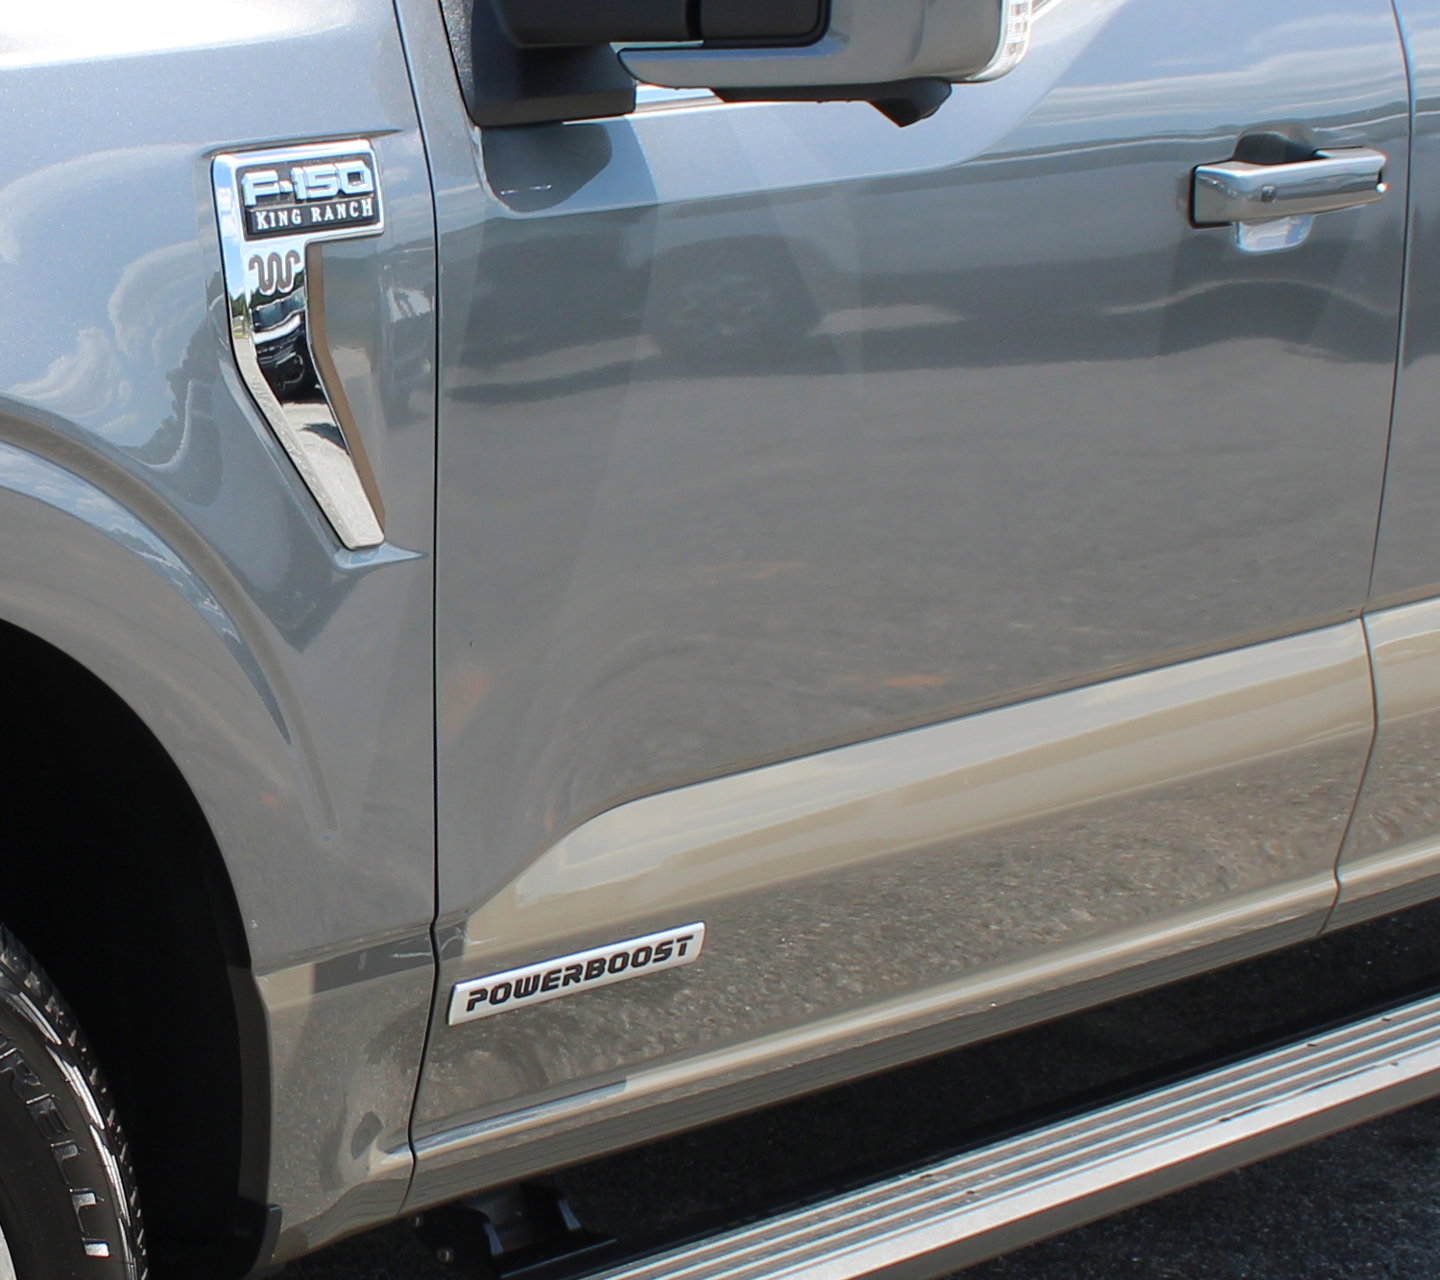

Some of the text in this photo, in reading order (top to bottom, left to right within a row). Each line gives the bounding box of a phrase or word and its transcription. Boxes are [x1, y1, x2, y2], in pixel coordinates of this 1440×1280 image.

[241, 160, 374, 207] F-150
[255, 197, 374, 231] KING RANCH
[466, 934, 694, 1013] POWERBOOST
